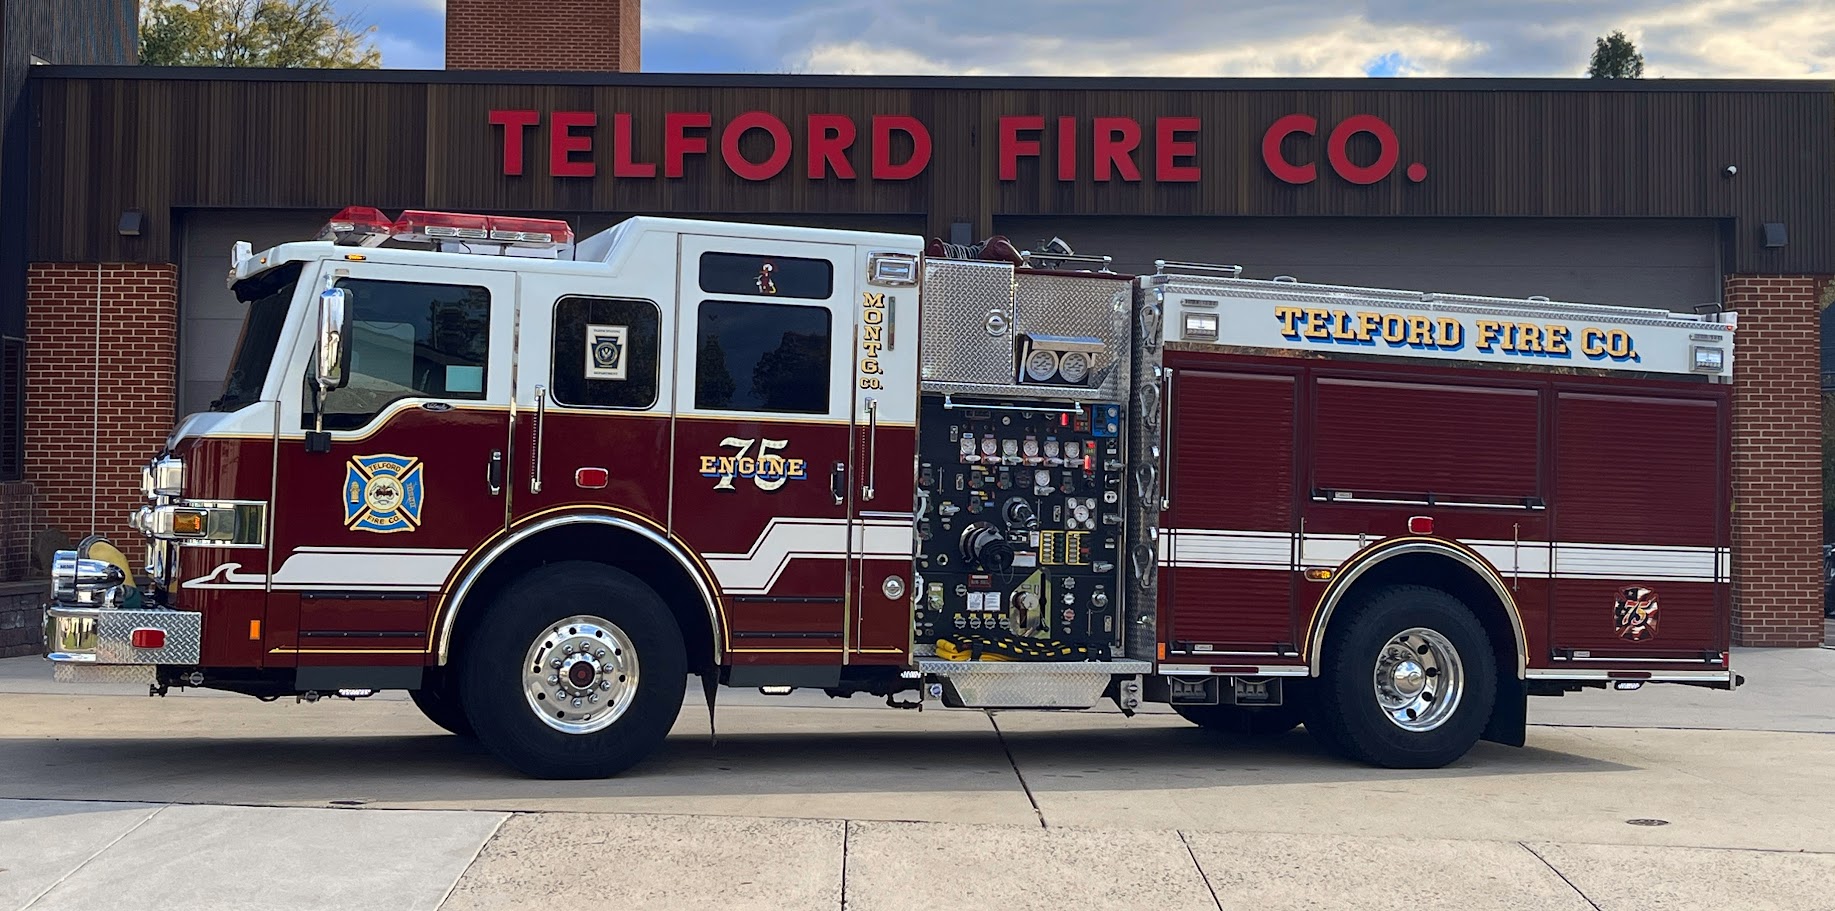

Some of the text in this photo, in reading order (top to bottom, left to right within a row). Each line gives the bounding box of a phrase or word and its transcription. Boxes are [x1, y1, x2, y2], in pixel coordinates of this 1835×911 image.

[488, 109, 1428, 185] TELFORD FIRE CO.
[860, 291, 886, 375] MONTG.
[1274, 305, 1642, 364] TELFORD FIRE CO.
[859, 376, 884, 391] CO.
[368, 462, 401, 472] TELFORD
[699, 455, 808, 480] ENGINE
[713, 436, 789, 491] 75
[366, 514, 385, 525] FIRE
[1621, 599, 1656, 626] 75
